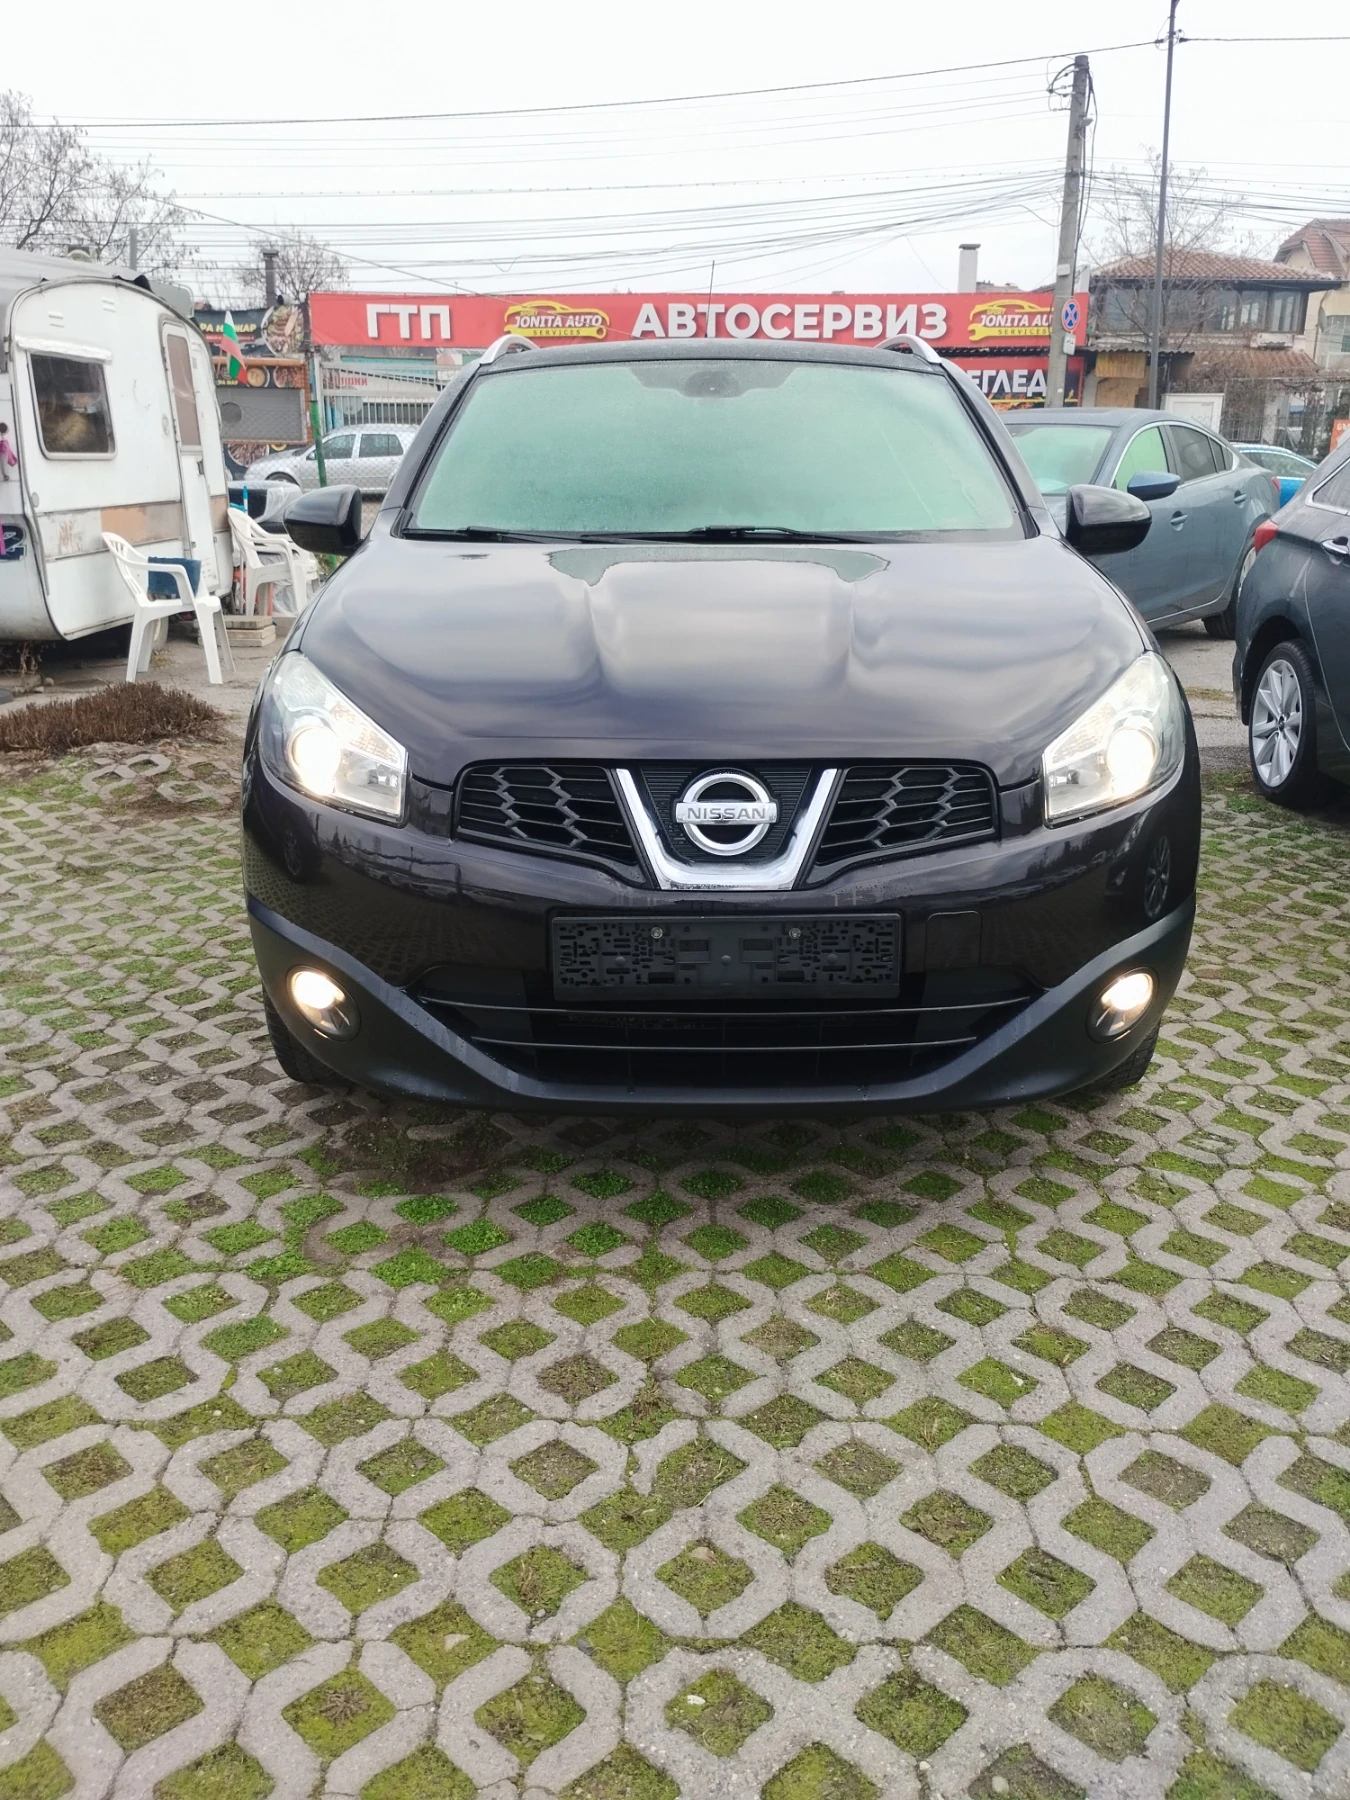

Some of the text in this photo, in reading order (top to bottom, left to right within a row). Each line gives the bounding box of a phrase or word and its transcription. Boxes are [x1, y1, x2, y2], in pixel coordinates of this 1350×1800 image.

[366, 304, 451, 339] ГТП
[514, 315, 603, 328] JONITA AUTO
[631, 303, 948, 340] АВТОСЕРВИЗ
[980, 315, 1052, 327] JONITA AU
[966, 368, 1047, 397] ЕГЛЕД
[687, 807, 766, 820] NISSAN
